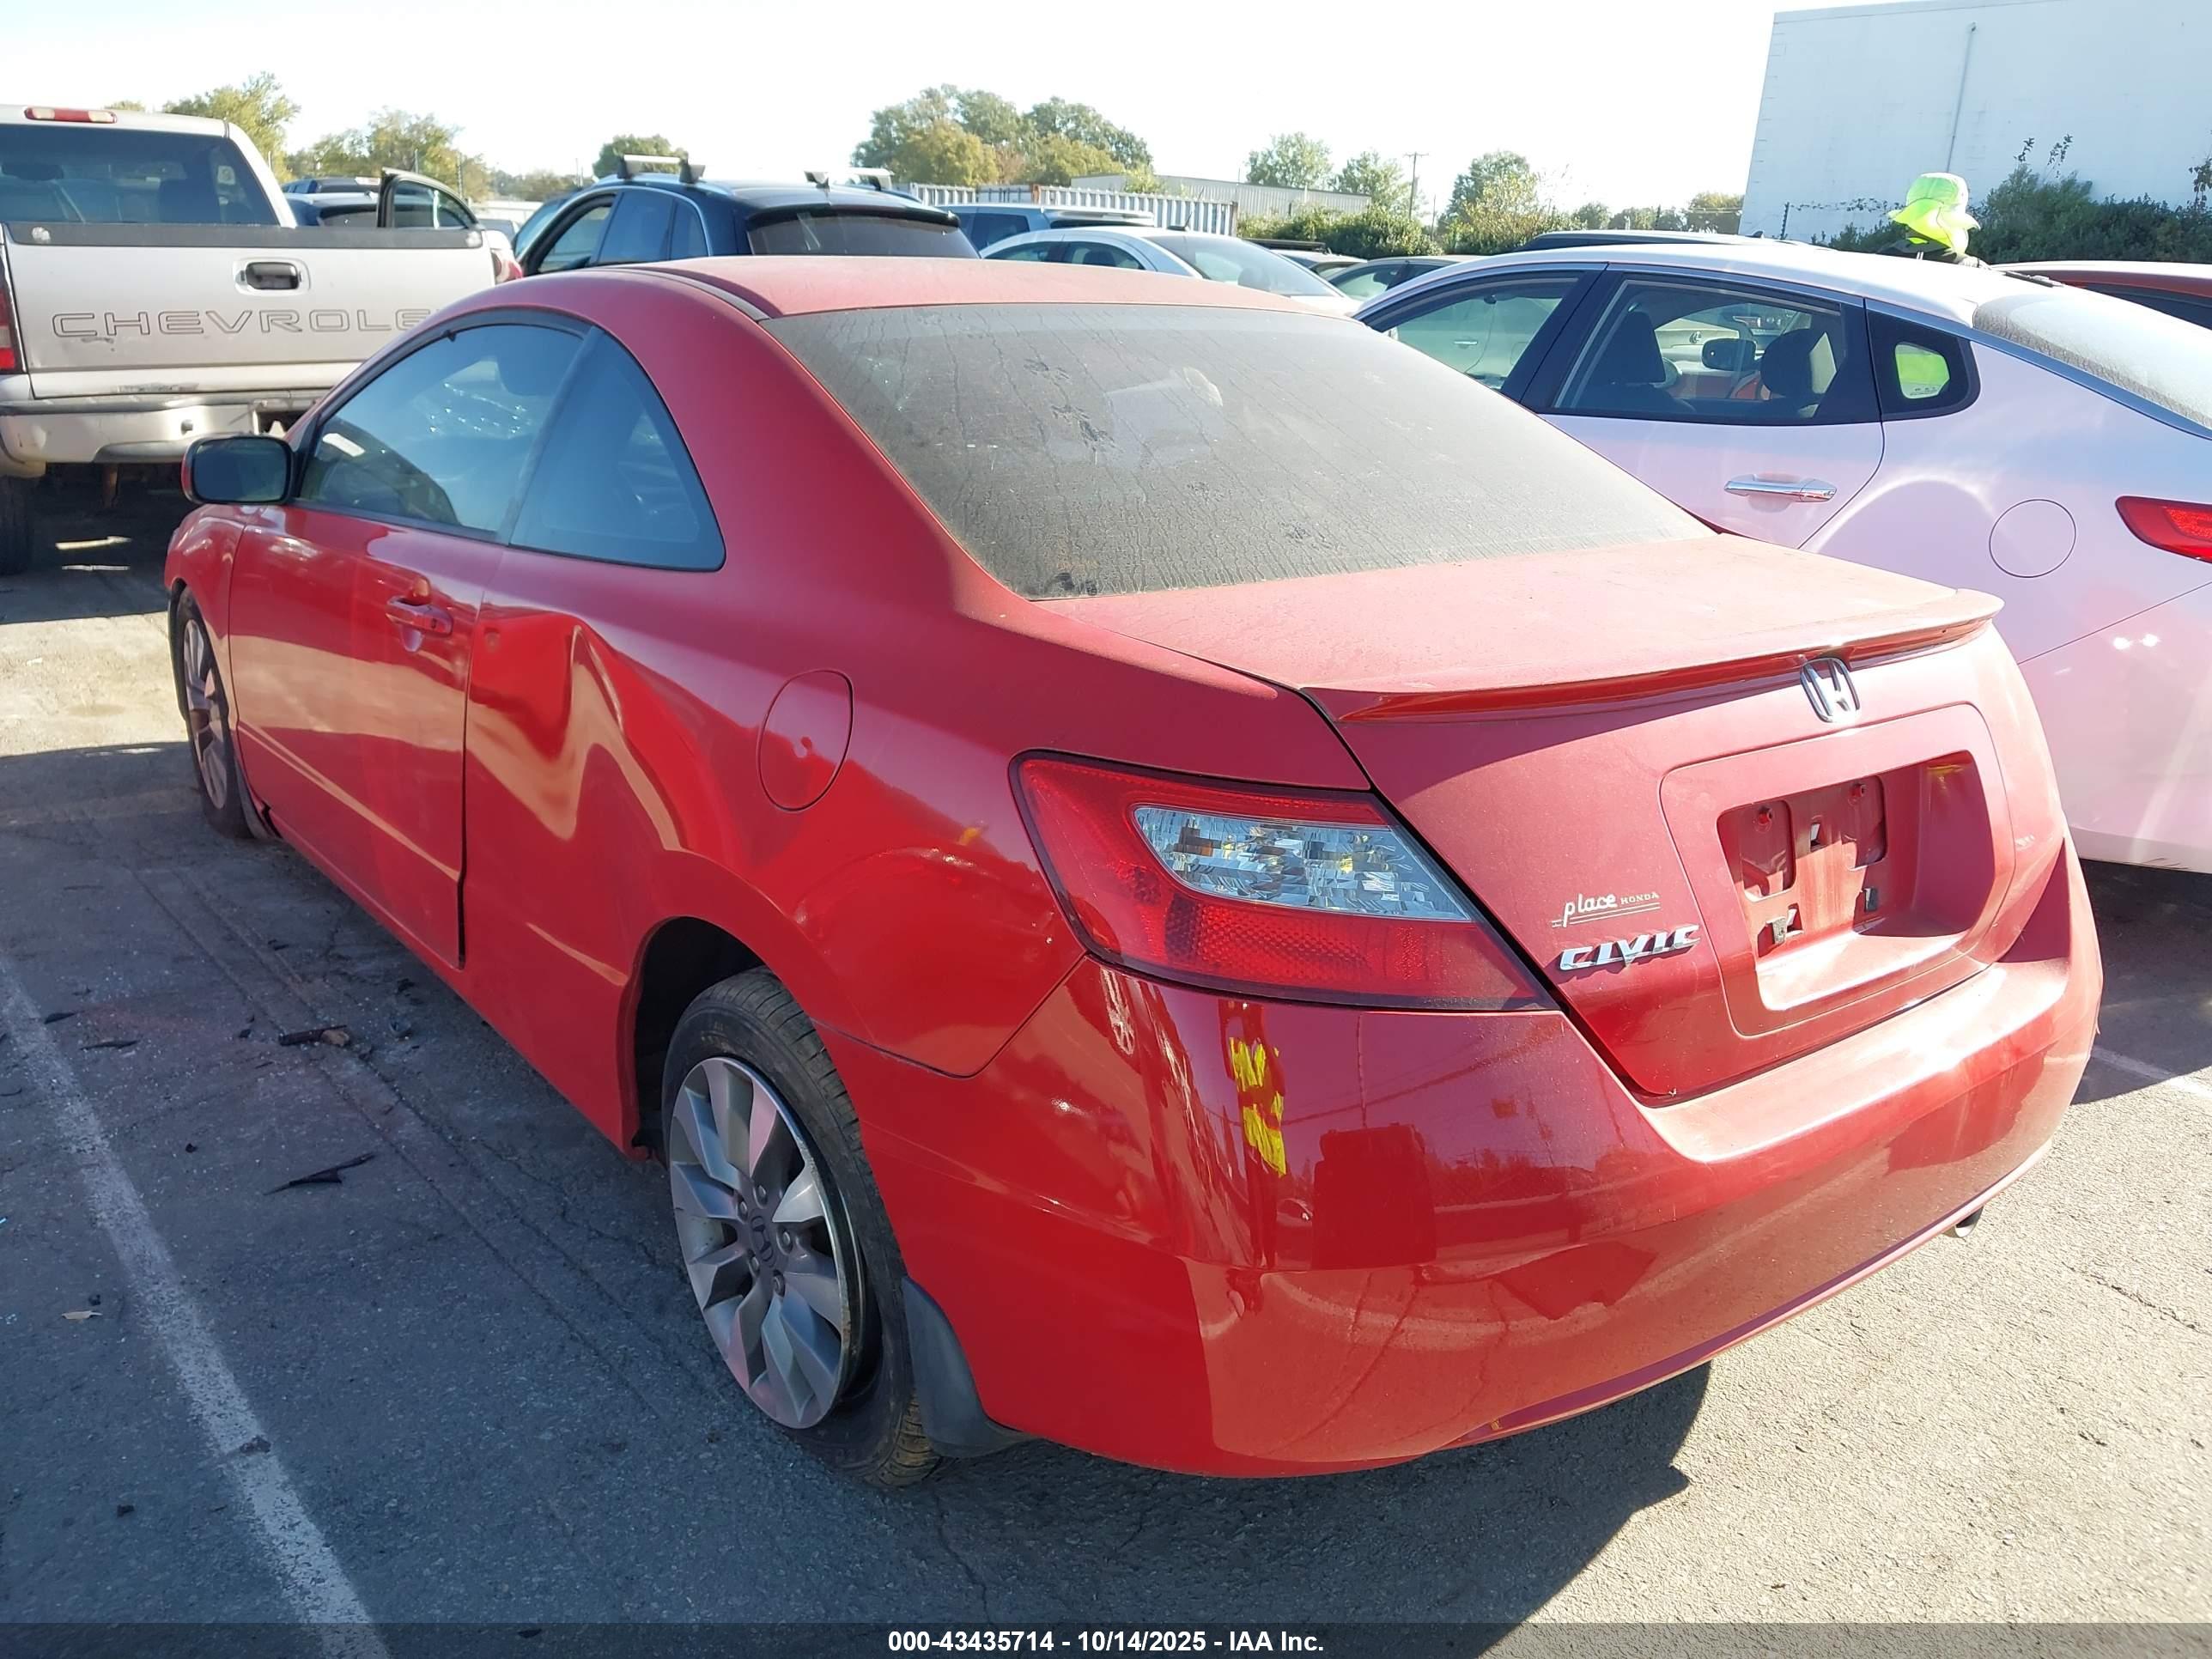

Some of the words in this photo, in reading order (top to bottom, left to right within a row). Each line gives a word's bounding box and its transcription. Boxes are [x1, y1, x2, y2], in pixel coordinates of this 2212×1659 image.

[52, 308, 441, 338] CHEVROLE
[1563, 893, 1618, 927] place
[1620, 891, 1660, 905] HONDA
[1559, 924, 1701, 970] CIVIC
